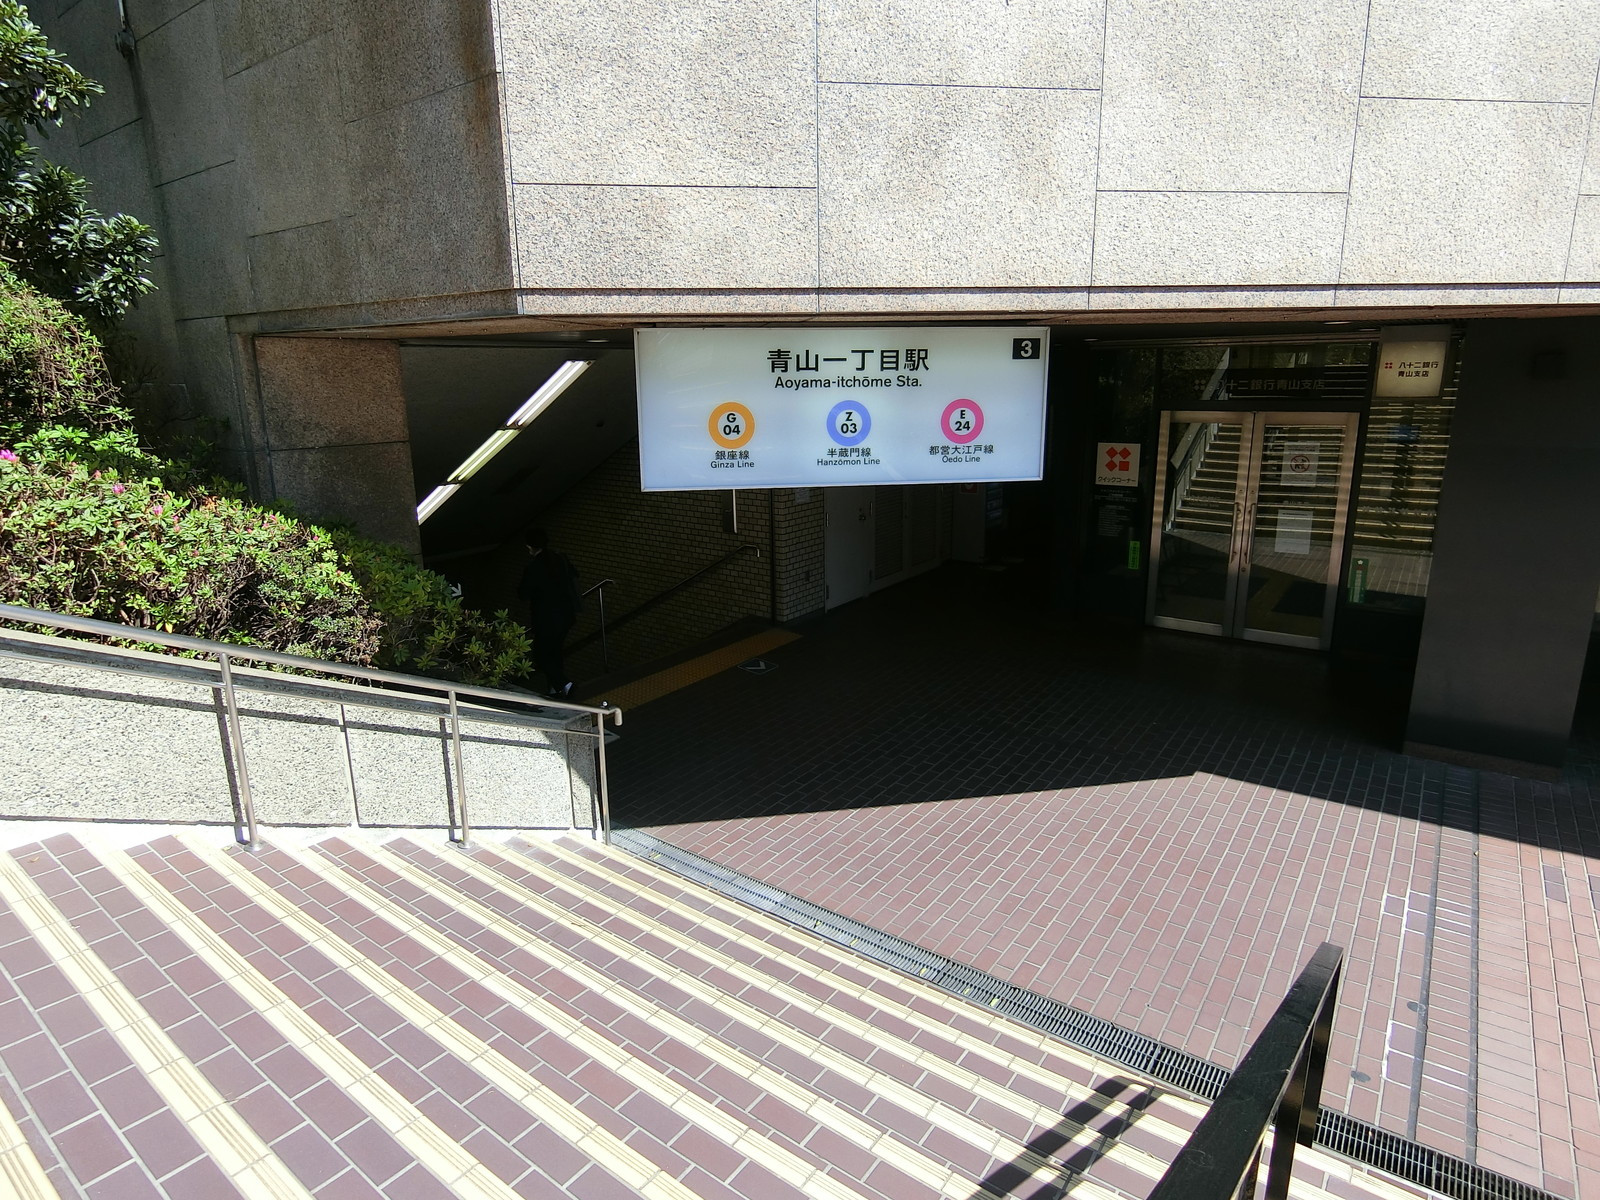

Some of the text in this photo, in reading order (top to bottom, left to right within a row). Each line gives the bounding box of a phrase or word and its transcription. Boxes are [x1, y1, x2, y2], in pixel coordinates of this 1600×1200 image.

[1020, 340, 1033, 358] 3
[767, 348, 930, 373] 青山一丁目駅
[1398, 361, 1439, 369] 八十二銀行
[1397, 370, 1430, 378] 青山支店
[774, 375, 923, 391] Aoyama-itchōme Sta.
[726, 413, 737, 424] G
[845, 411, 853, 422] Z
[959, 409, 966, 420] E
[723, 424, 741, 436] 04
[841, 422, 858, 434] 03
[954, 420, 971, 431] 24
[714, 449, 750, 461] 銀座線
[826, 447, 872, 458] 半蔵門線
[929, 444, 995, 456] 都営大江戸線
[711, 460, 755, 469] Ginza Line
[863, 457, 881, 466] Line
[965, 455, 981, 463] Line
